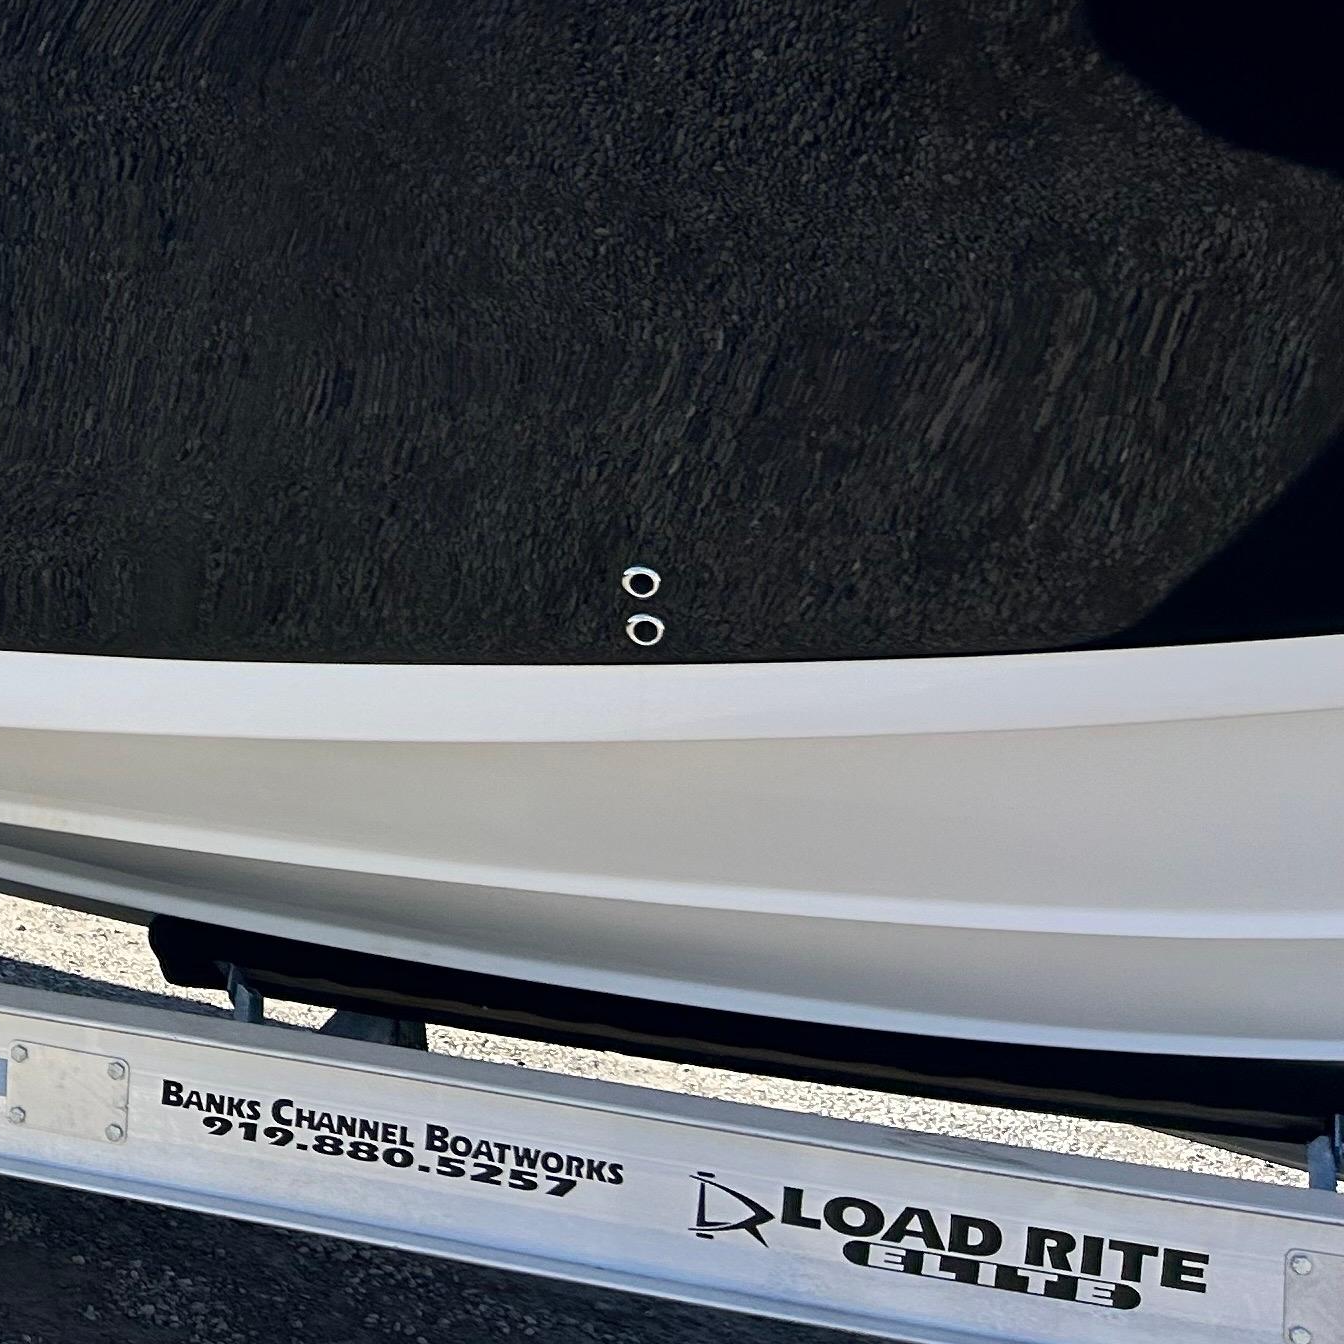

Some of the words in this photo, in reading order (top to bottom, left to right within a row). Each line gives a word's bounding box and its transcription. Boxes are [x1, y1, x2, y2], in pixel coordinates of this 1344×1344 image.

[161, 1078, 261, 1121] BANKS
[270, 1097, 415, 1149] CHANNEL
[425, 1124, 625, 1186] BOATWORKS
[202, 1116, 578, 1199] 919.880.5257
[780, 1186, 1004, 1257] LOAD
[1024, 1225, 1210, 1294] RITE
[865, 1245, 1120, 1306] ELITE
